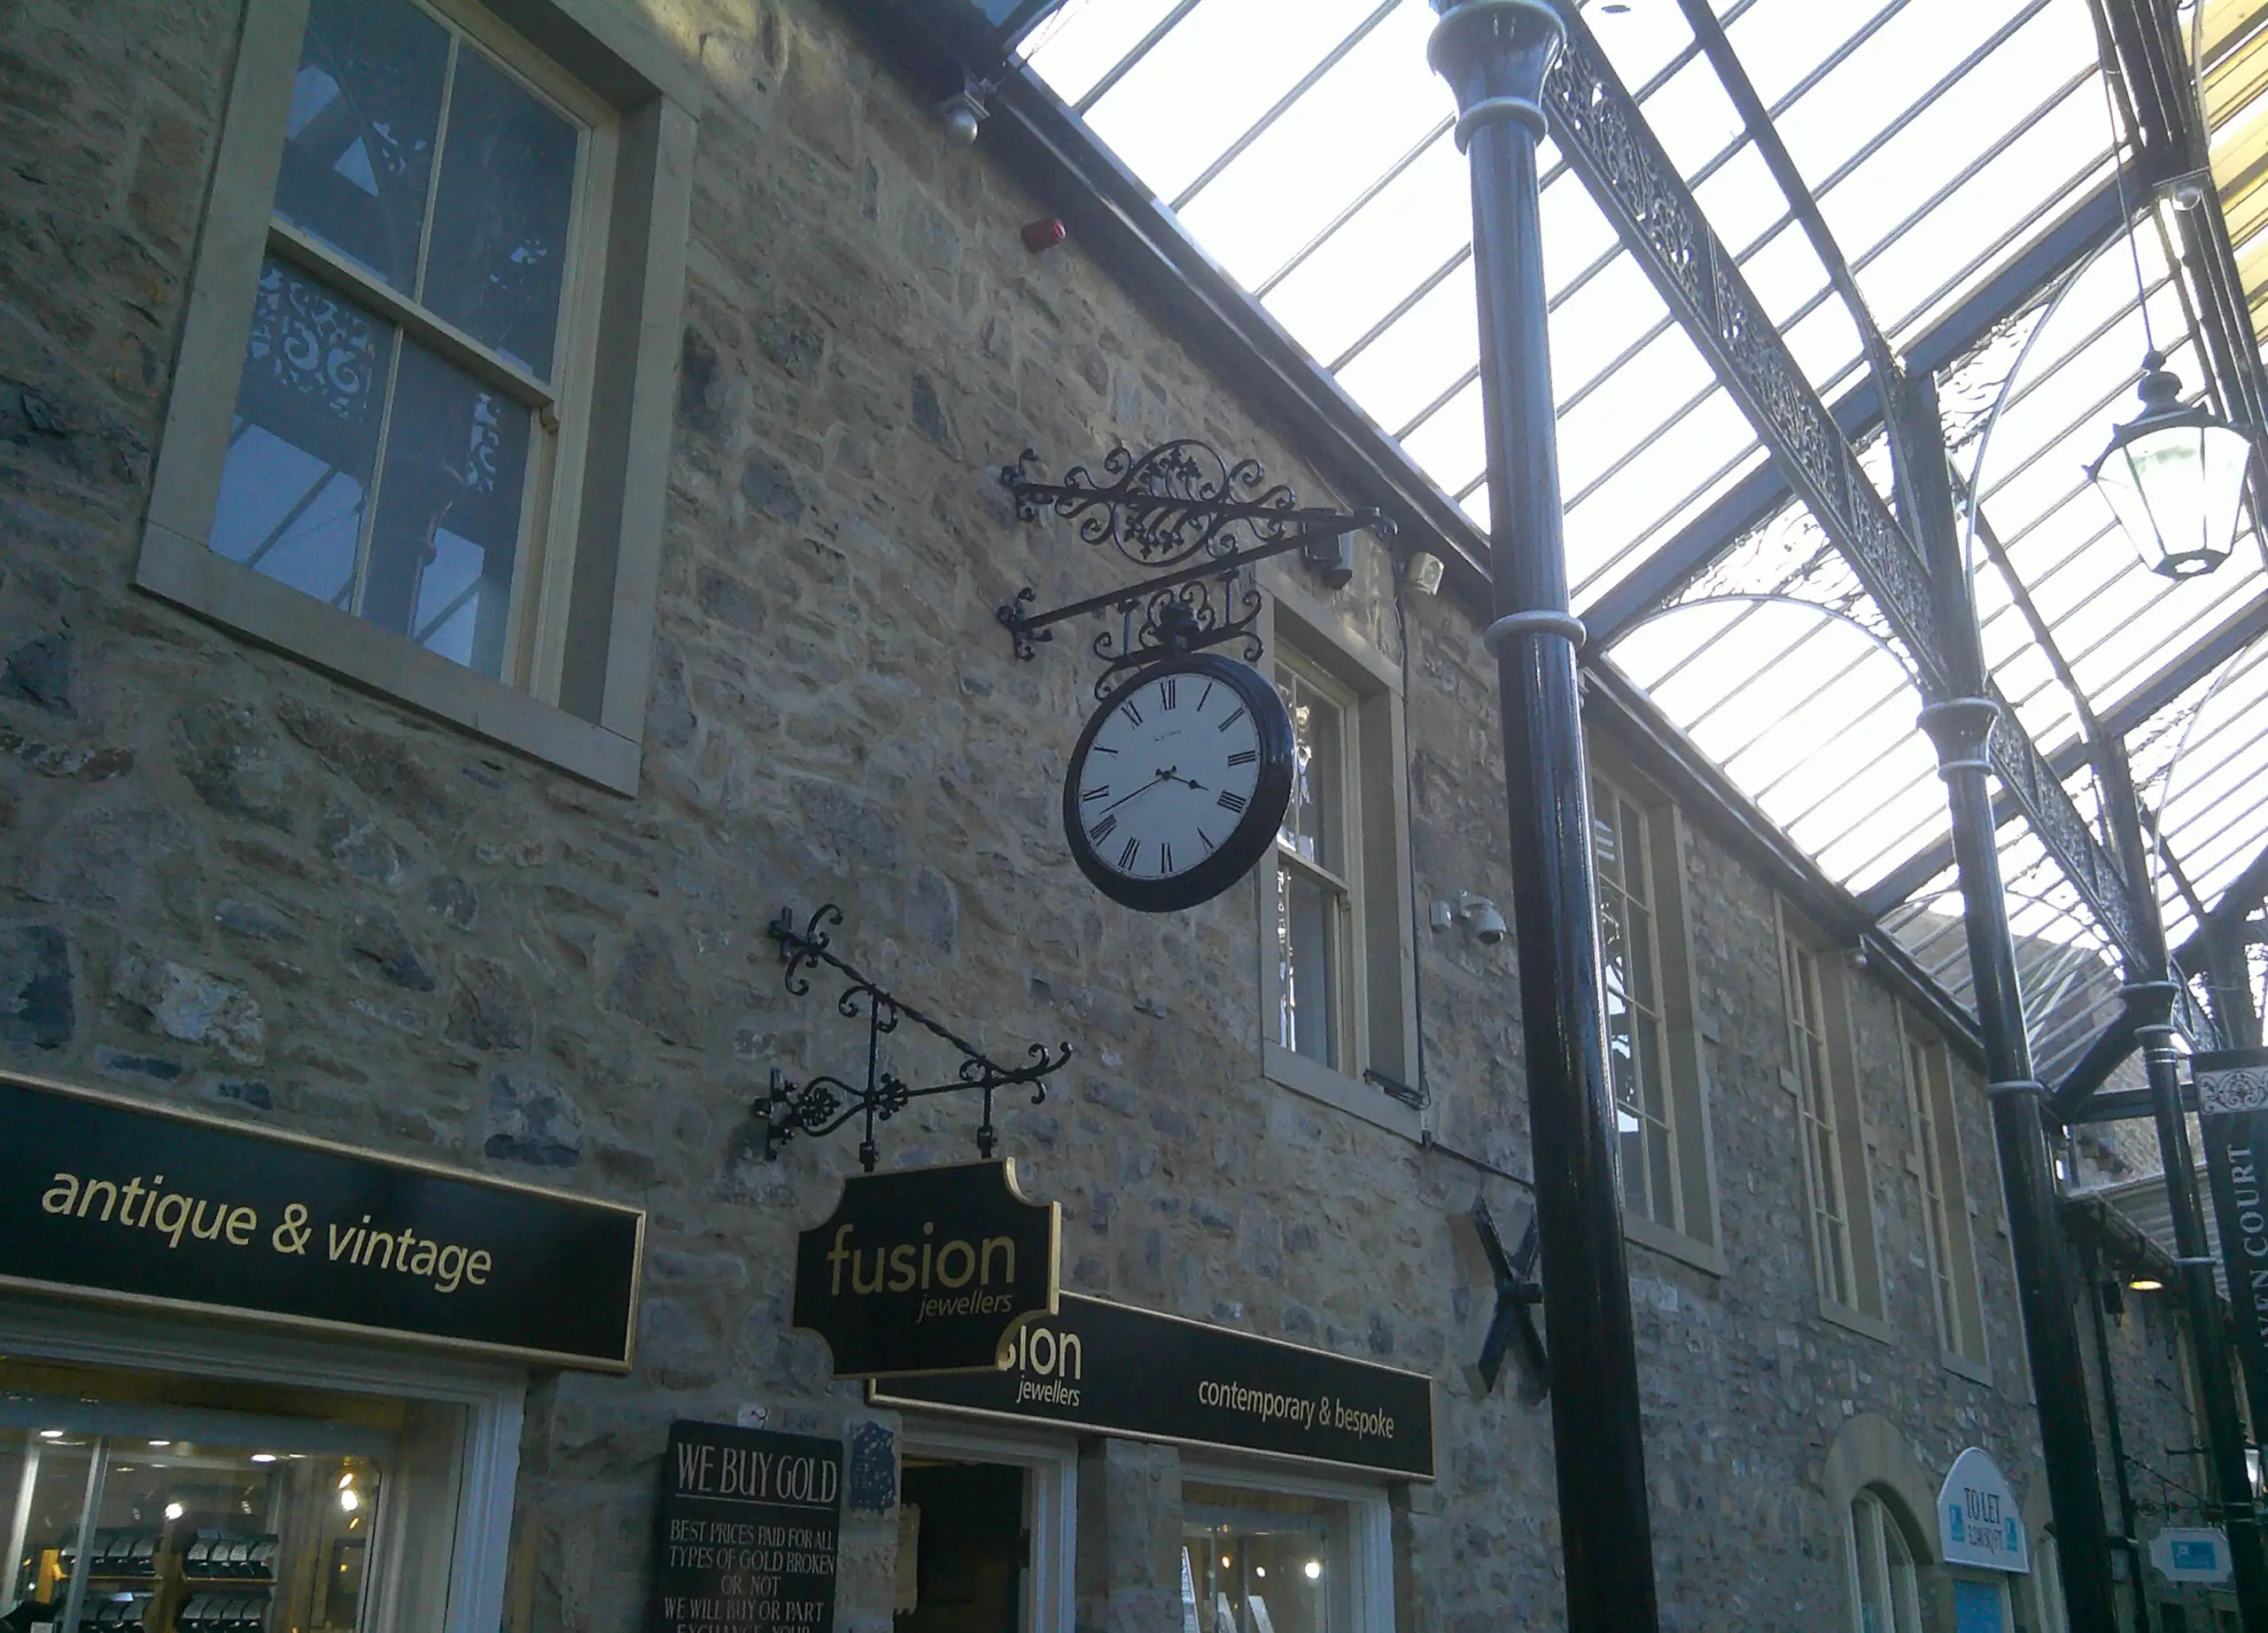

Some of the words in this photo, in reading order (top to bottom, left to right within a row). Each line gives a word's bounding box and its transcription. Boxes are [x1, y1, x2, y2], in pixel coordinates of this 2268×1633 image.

[2226, 1144, 2268, 1256] COURT
[42, 1172, 258, 1248] antique
[272, 1202, 313, 1255] &
[328, 1214, 493, 1293] vintage
[827, 1221, 1015, 1296] fusion
[916, 1290, 1013, 1324] jewellers
[1016, 1375, 1081, 1406] jewellers
[1199, 1380, 1315, 1430] contemporary
[1319, 1396, 1331, 1426] &
[1335, 1399, 1394, 1439] bespoke
[677, 1442, 714, 1492] WE
[719, 1448, 773, 1497] BUY
[776, 1455, 837, 1504] GOLD
[670, 1519, 707, 1543] BEST
[710, 1522, 754, 1545] PRICES
[758, 1526, 785, 1547] PAID
[788, 1528, 813, 1549] FOR
[815, 1530, 834, 1551] ALL
[670, 1545, 713, 1568] TYPES
[717, 1547, 735, 1570] OF
[739, 1549, 784, 1572] GOLD
[786, 1552, 835, 1575] BROKEN
[721, 1575, 742, 1595] OR
[750, 1575, 781, 1598] NOT
[664, 1597, 686, 1620] WE
[689, 1598, 721, 1621] WILL
[726, 1598, 757, 1621] BUY
[759, 1600, 781, 1621] OR
[785, 1600, 826, 1622] PART
